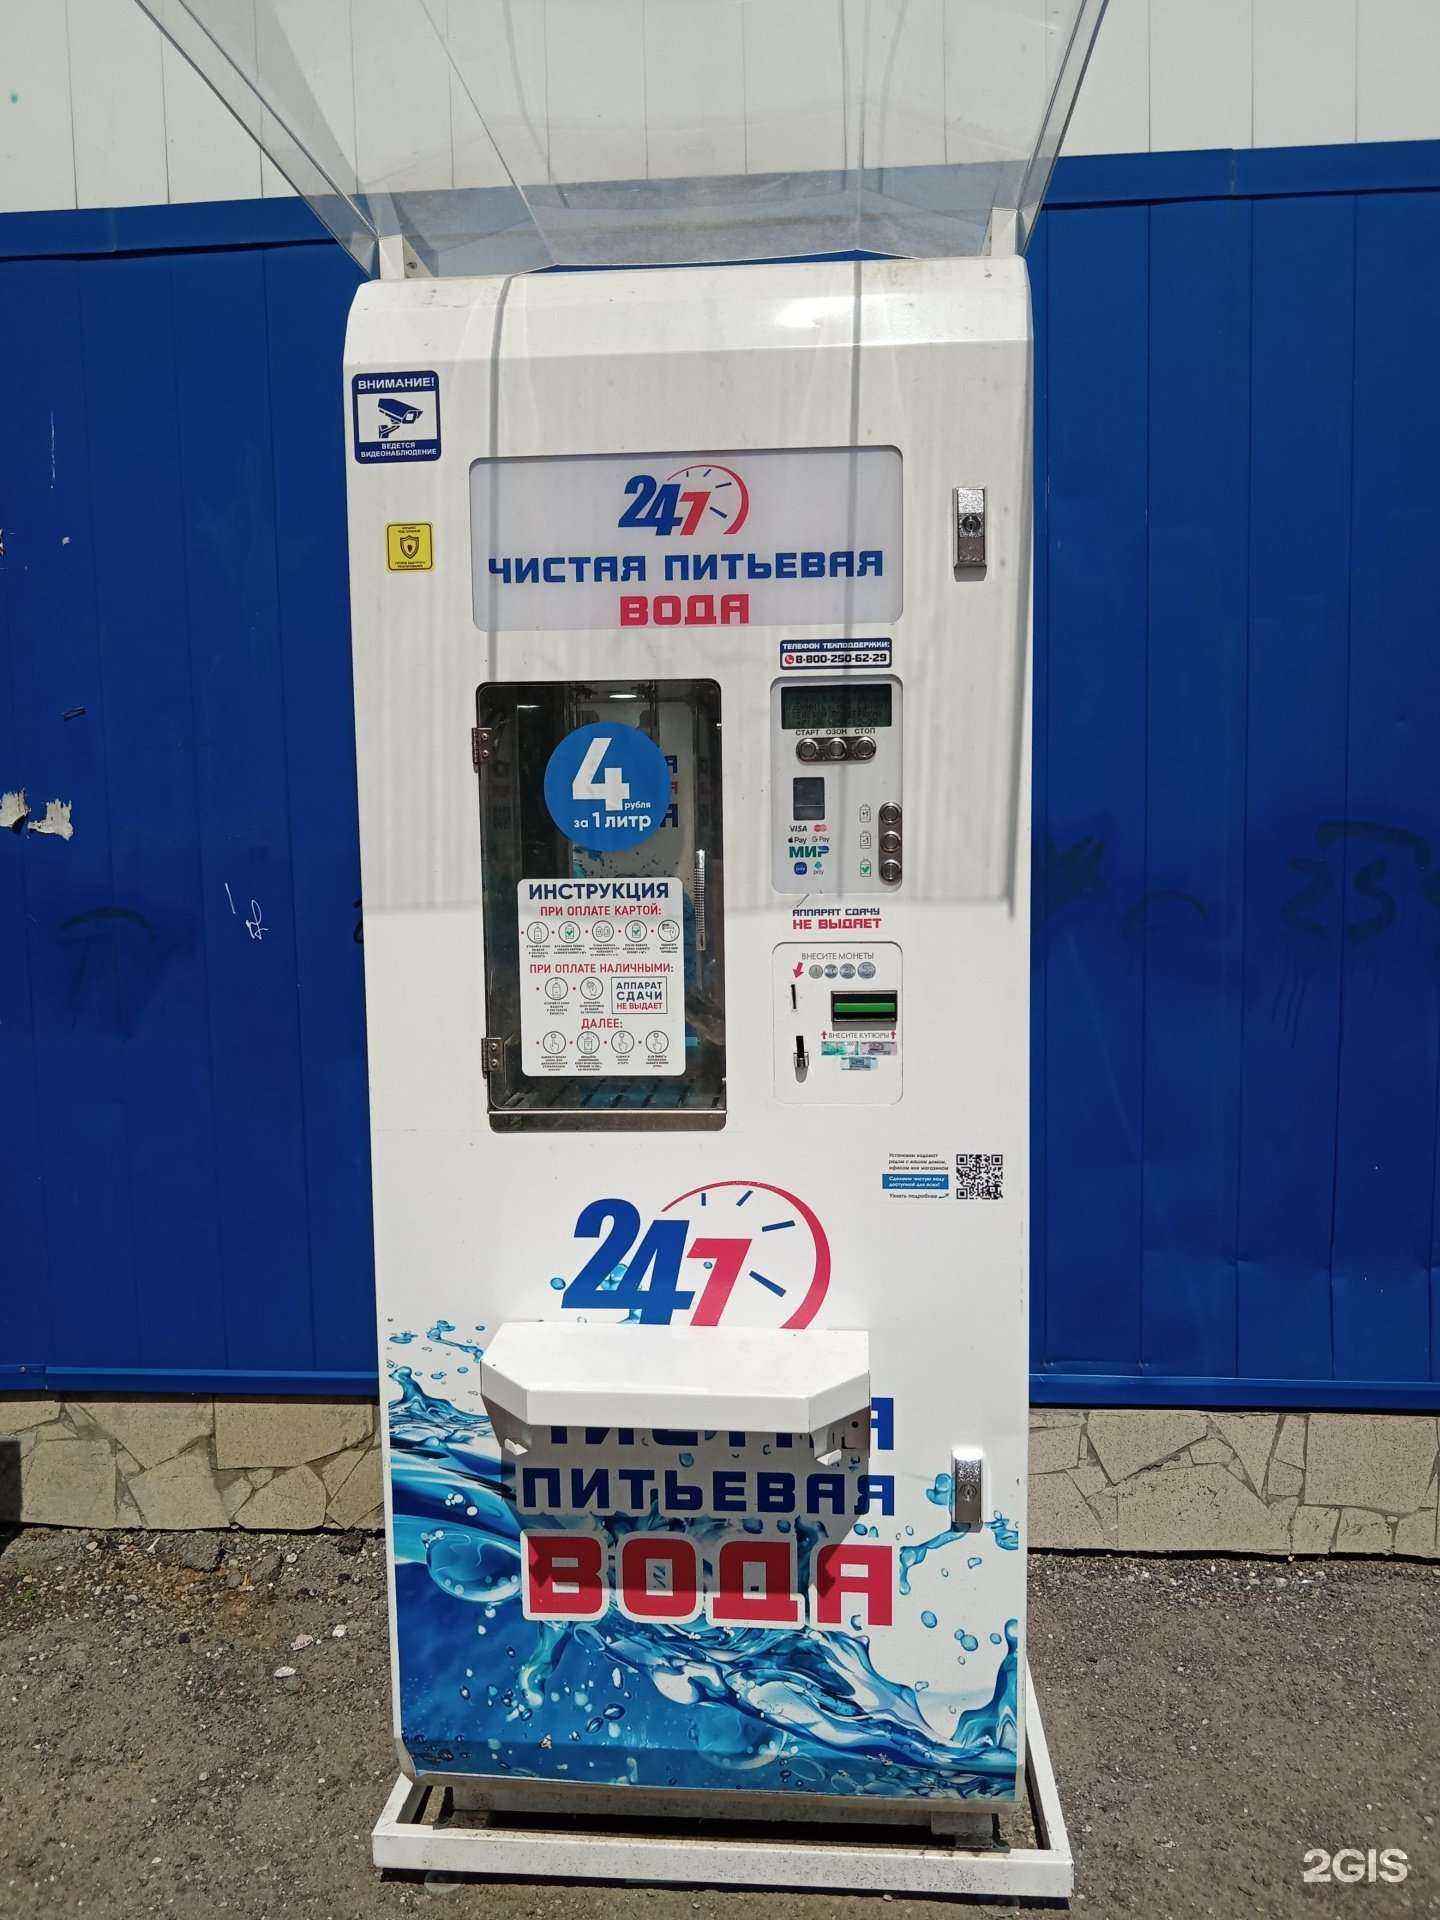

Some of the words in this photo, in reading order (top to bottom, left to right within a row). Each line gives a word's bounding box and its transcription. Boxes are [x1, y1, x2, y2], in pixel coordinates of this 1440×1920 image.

[358, 377, 435, 390] ВНИМАНИЕ!
[360, 448, 437, 458] ВИДЕОНАБЛЮДЕНИЕ
[488, 555, 646, 584] ЧИСТАЯ
[665, 550, 883, 582] ПИТЬЕВАЯ
[620, 593, 750, 626] ВОДА
[823, 642, 890, 650] ТЕХПОДДЕРЖКИ:
[796, 654, 887, 664] 8-800-250-62-29
[572, 737, 630, 811] 4
[624, 800, 651, 810] рубля
[574, 818, 588, 828] за
[592, 812, 600, 828] 1
[605, 815, 651, 831] литр
[789, 846, 829, 858] МИР
[529, 882, 669, 901] ИНСТРУКЦИЯ
[540, 907, 563, 916] ПРИ
[567, 905, 610, 916] ОПЛАТЕ
[614, 903, 662, 915] КАРТОЙ:
[793, 908, 841, 916] АППАРАТ
[845, 908, 880, 916] СДАЧУ
[793, 919, 812, 930] НЕ
[818, 918, 882, 930] ВЫДАЕТ
[530, 964, 551, 974] ПРИ
[555, 964, 596, 973] ОПЛАТЕ
[600, 963, 674, 973] НАЛИЧНЫМИ:
[616, 981, 662, 990] АППАРАТ
[617, 991, 662, 1002] СДАЧИ
[581, 1018, 623, 1030] ДАЛЕЕ:
[522, 1468, 895, 1516] ПИТЬЕВАЯ
[528, 1536, 893, 1626] ВОДА
